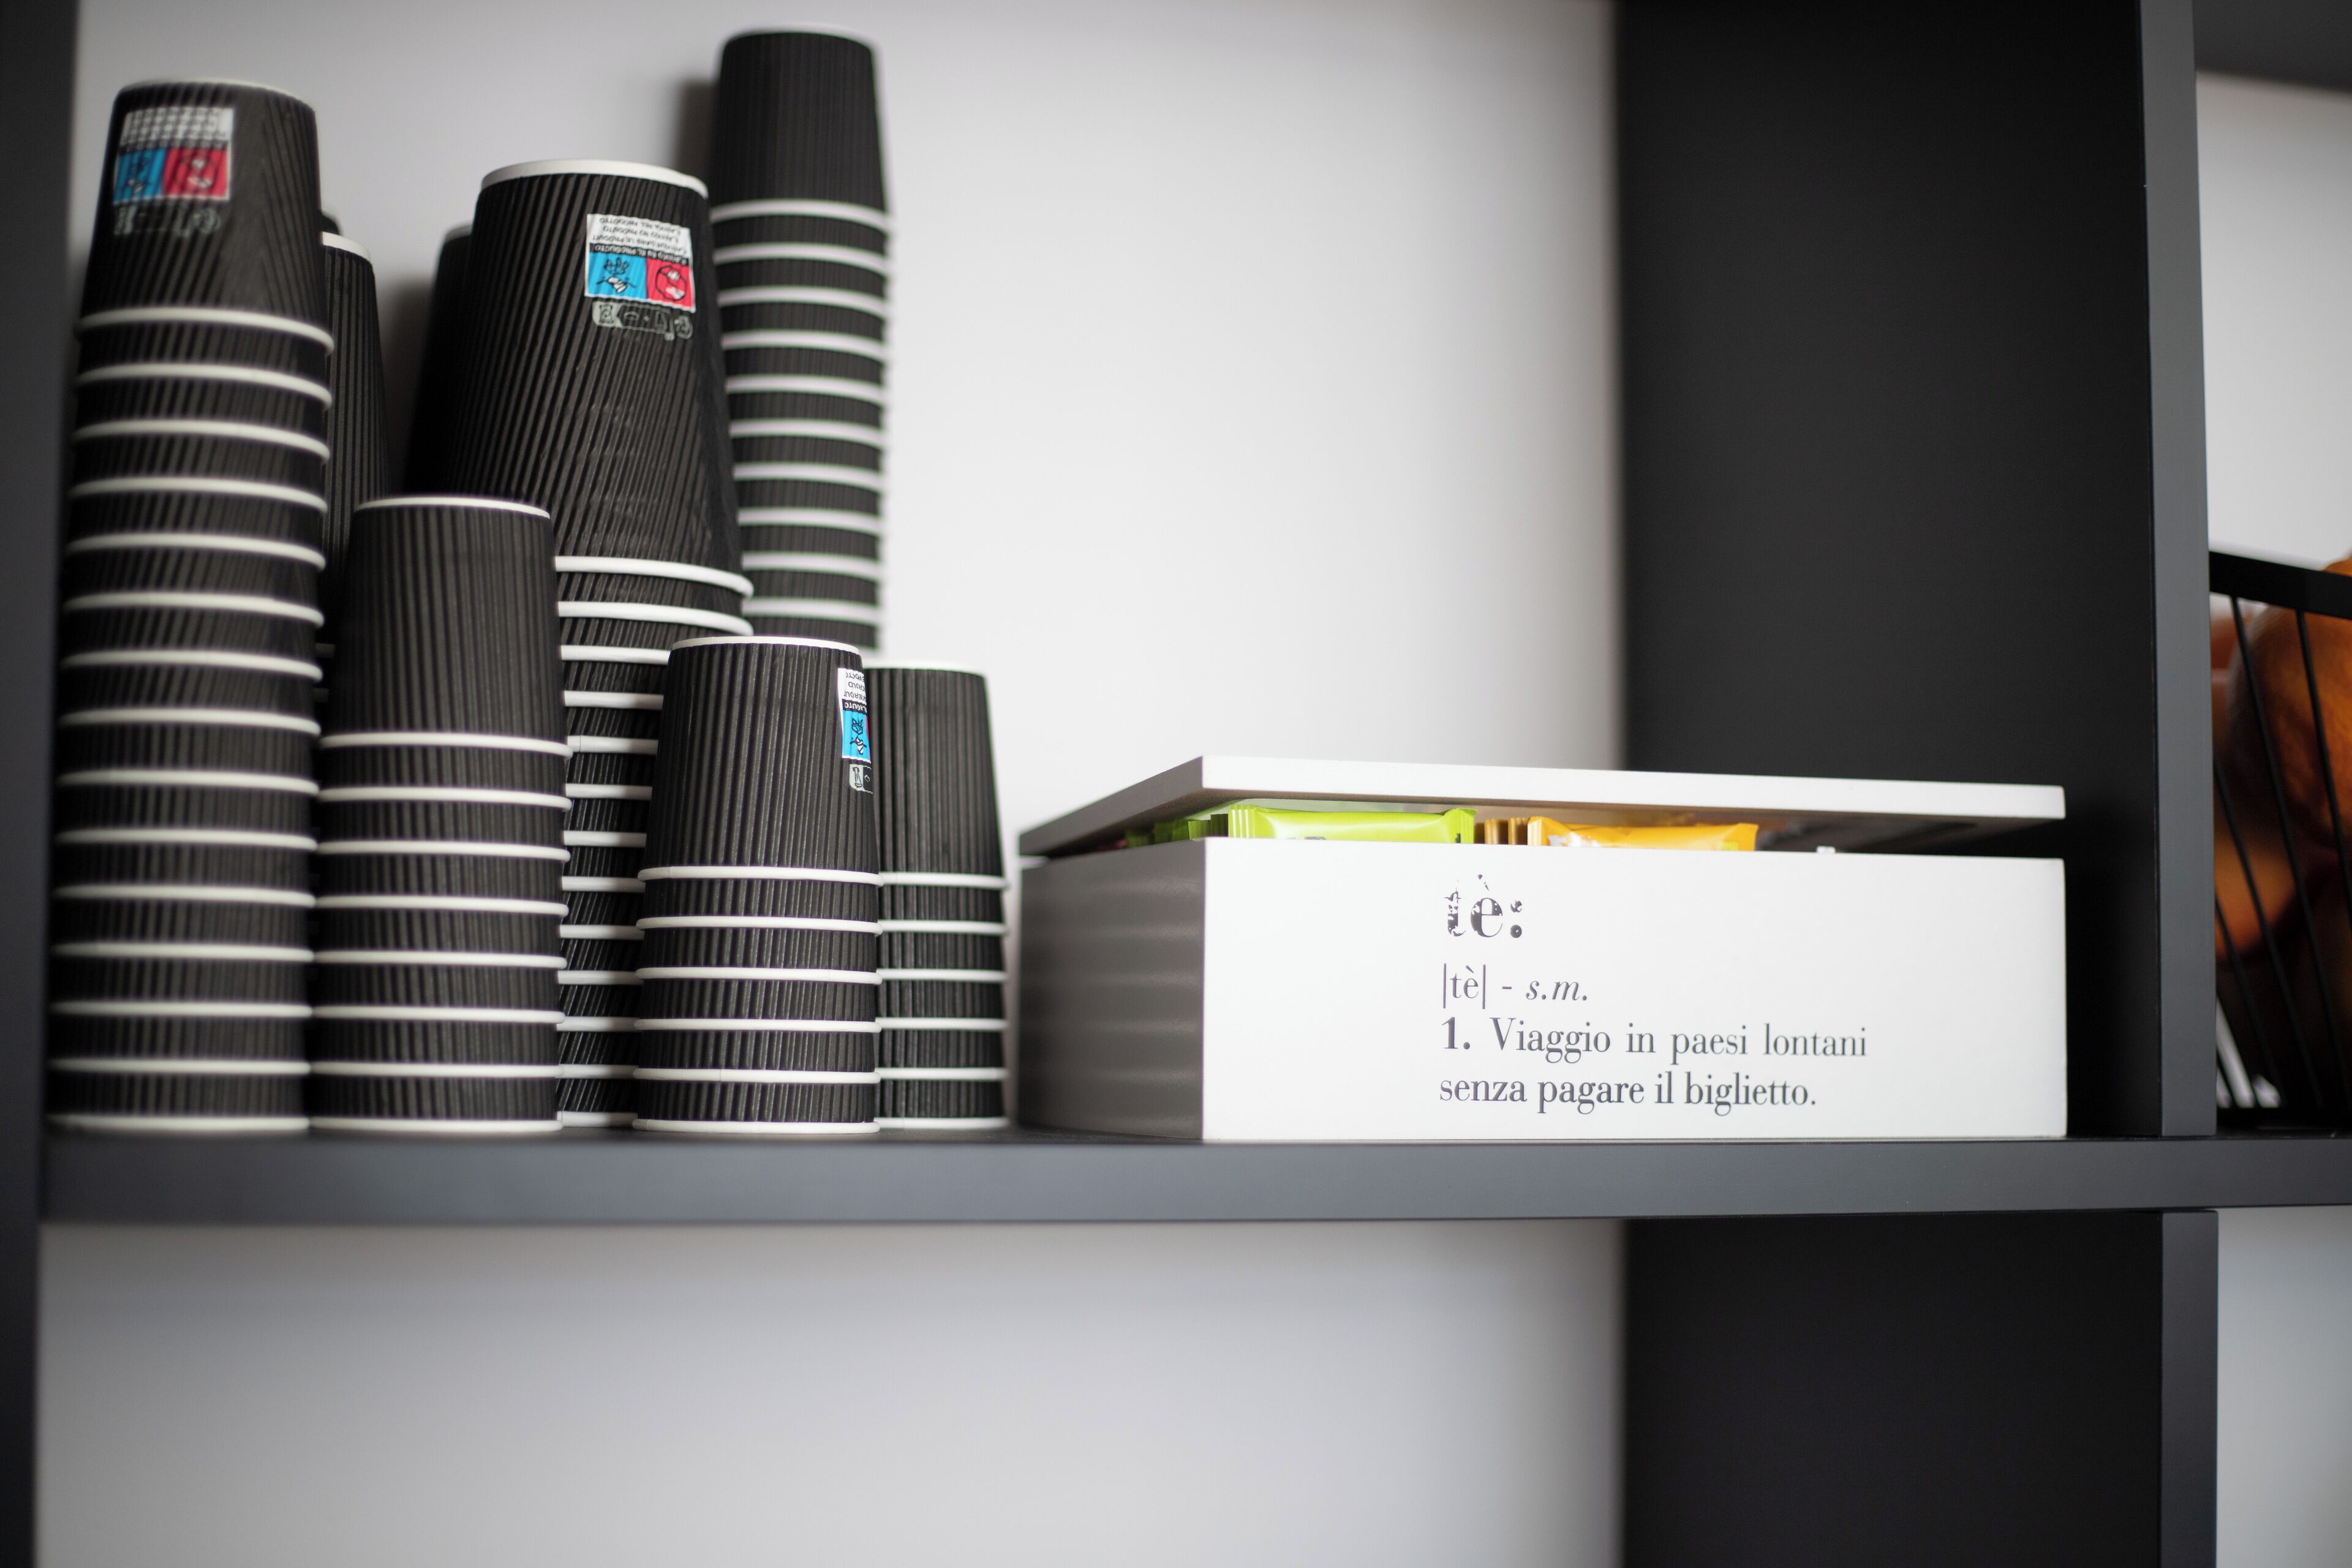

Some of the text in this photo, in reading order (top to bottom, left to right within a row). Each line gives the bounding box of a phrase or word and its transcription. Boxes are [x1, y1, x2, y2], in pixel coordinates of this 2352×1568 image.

[1525, 980, 1588, 1001] s.m.
[1441, 1016, 1867, 1066] 1. Viaggio in paesi lontani
[1439, 1070, 1816, 1117] senza pagare il biglietto.
